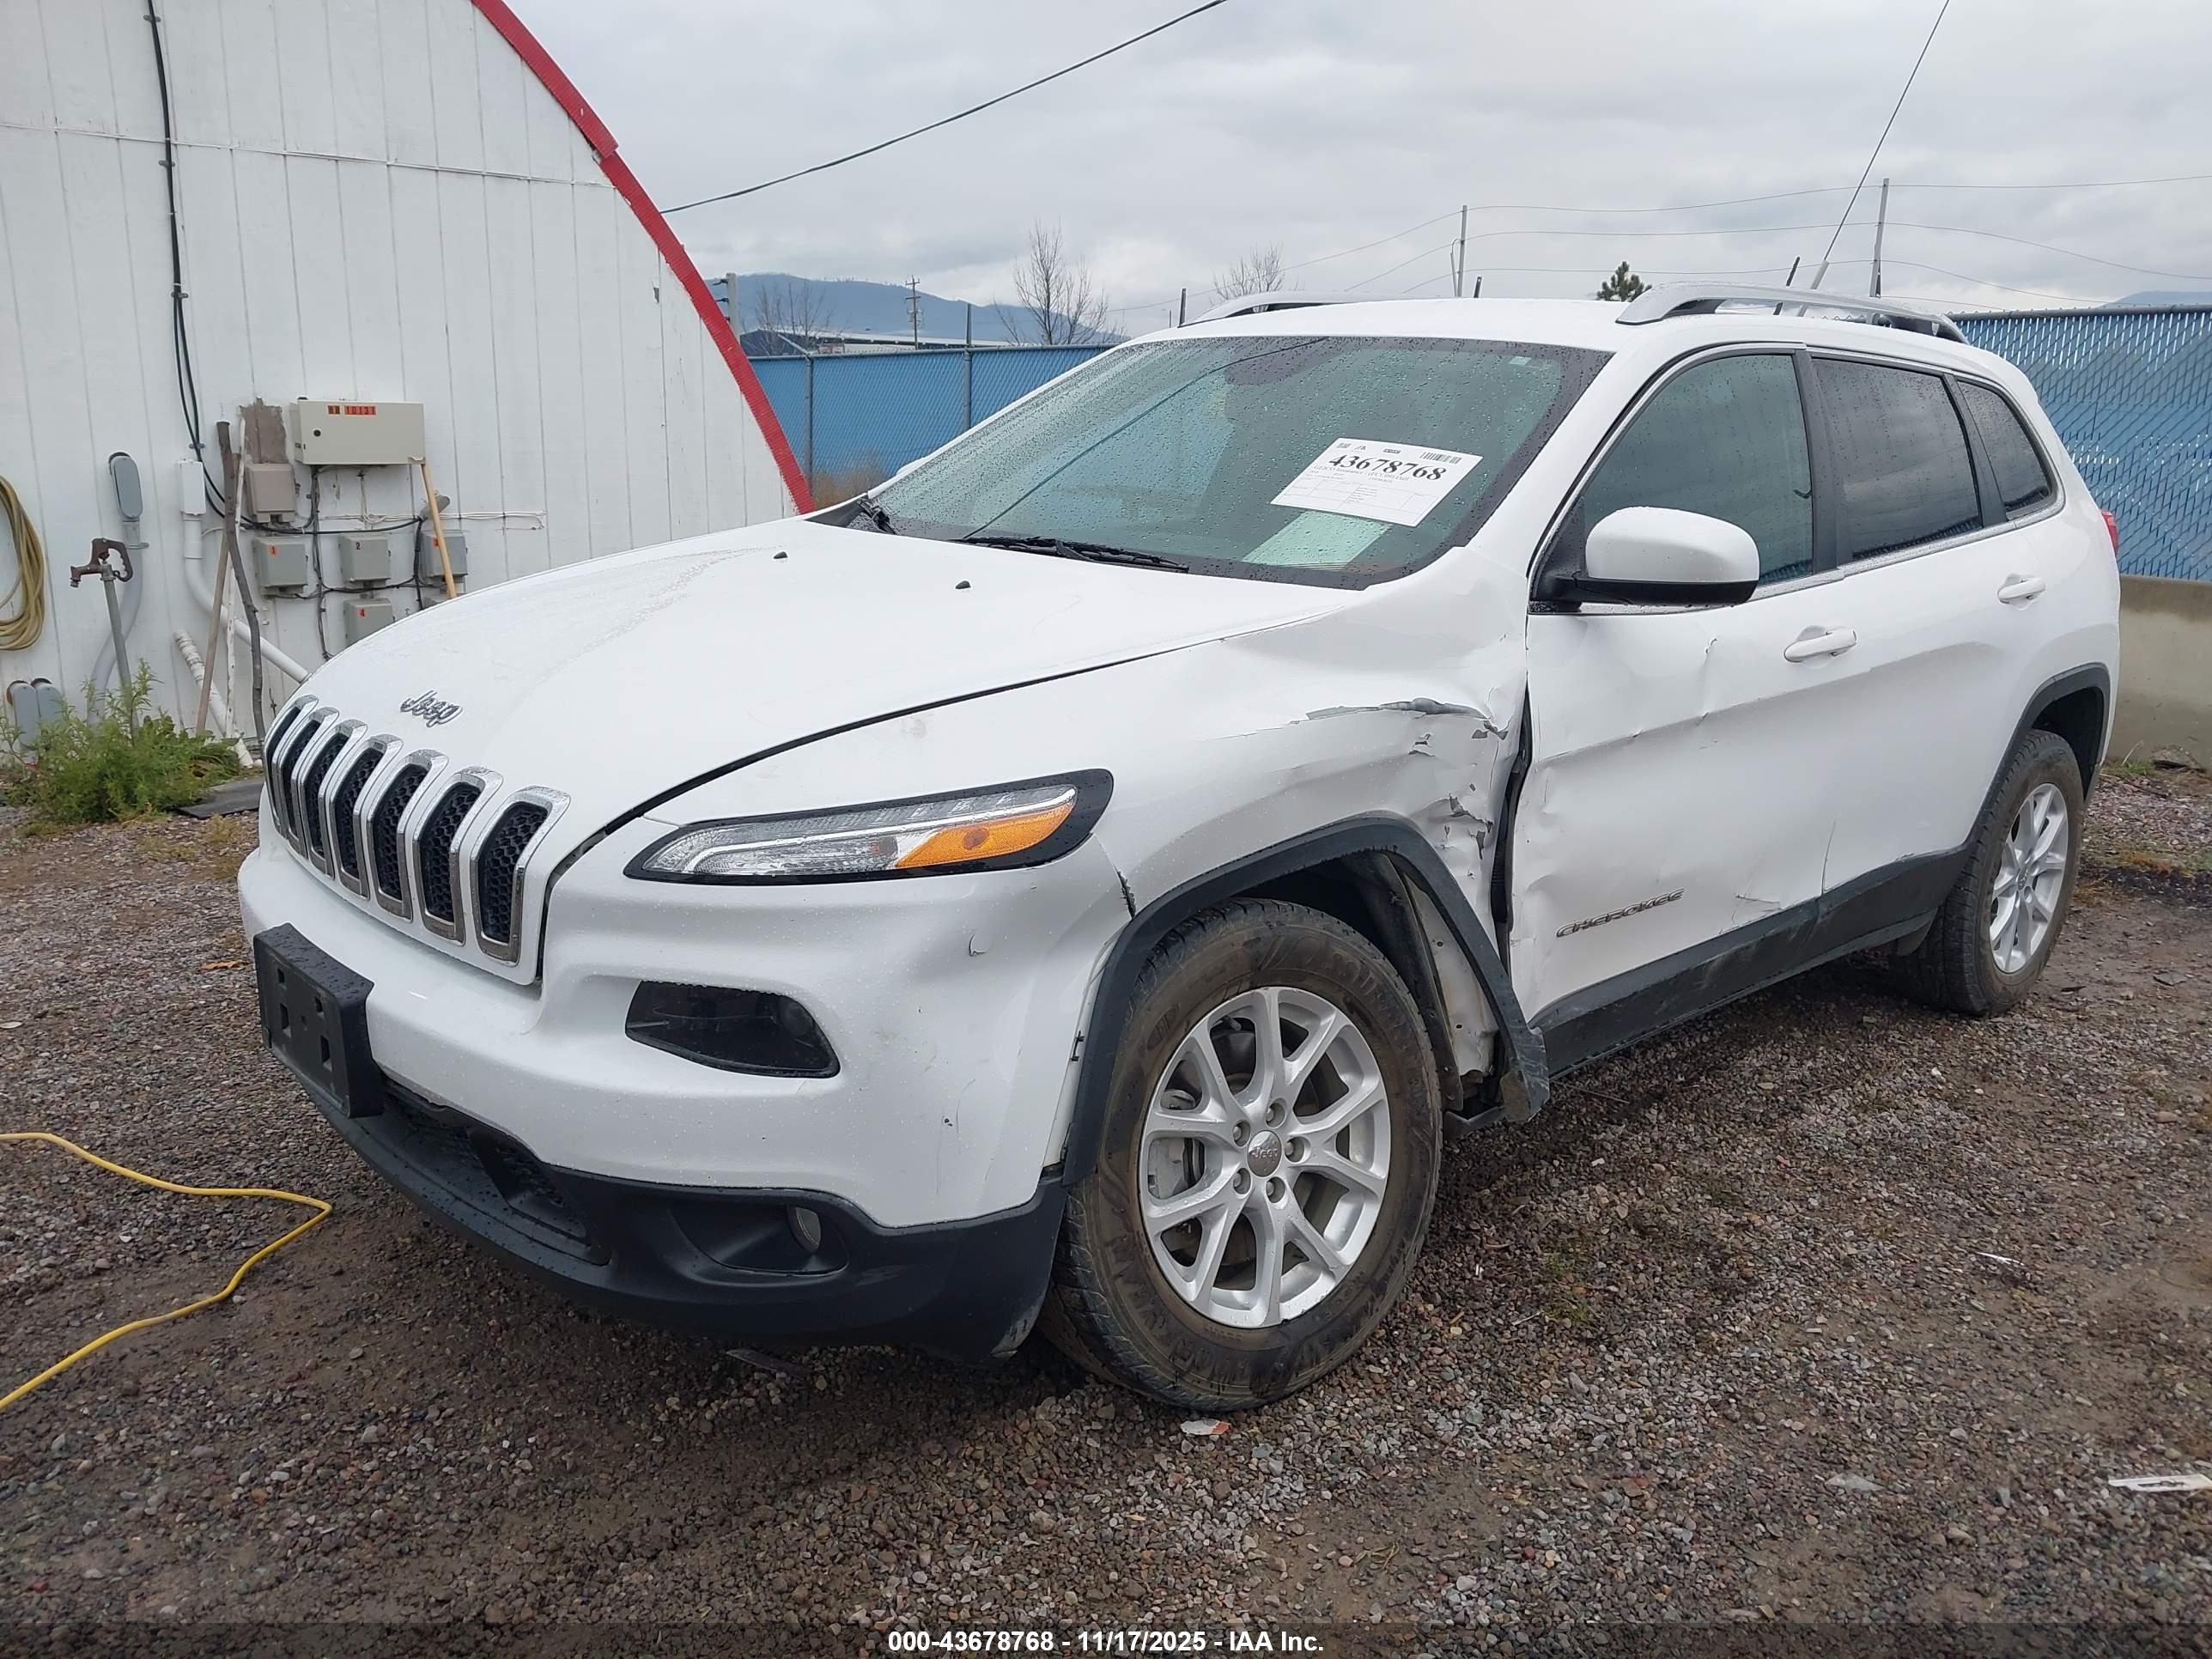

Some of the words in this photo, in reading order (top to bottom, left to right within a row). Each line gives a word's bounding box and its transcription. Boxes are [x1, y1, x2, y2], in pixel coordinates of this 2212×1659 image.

[1328, 454, 1447, 481] 43678768
[356, 542, 361, 550] 2
[359, 608, 365, 617] 4
[400, 688, 464, 728] Jeep
[1250, 1146, 1279, 1161] Jeep
